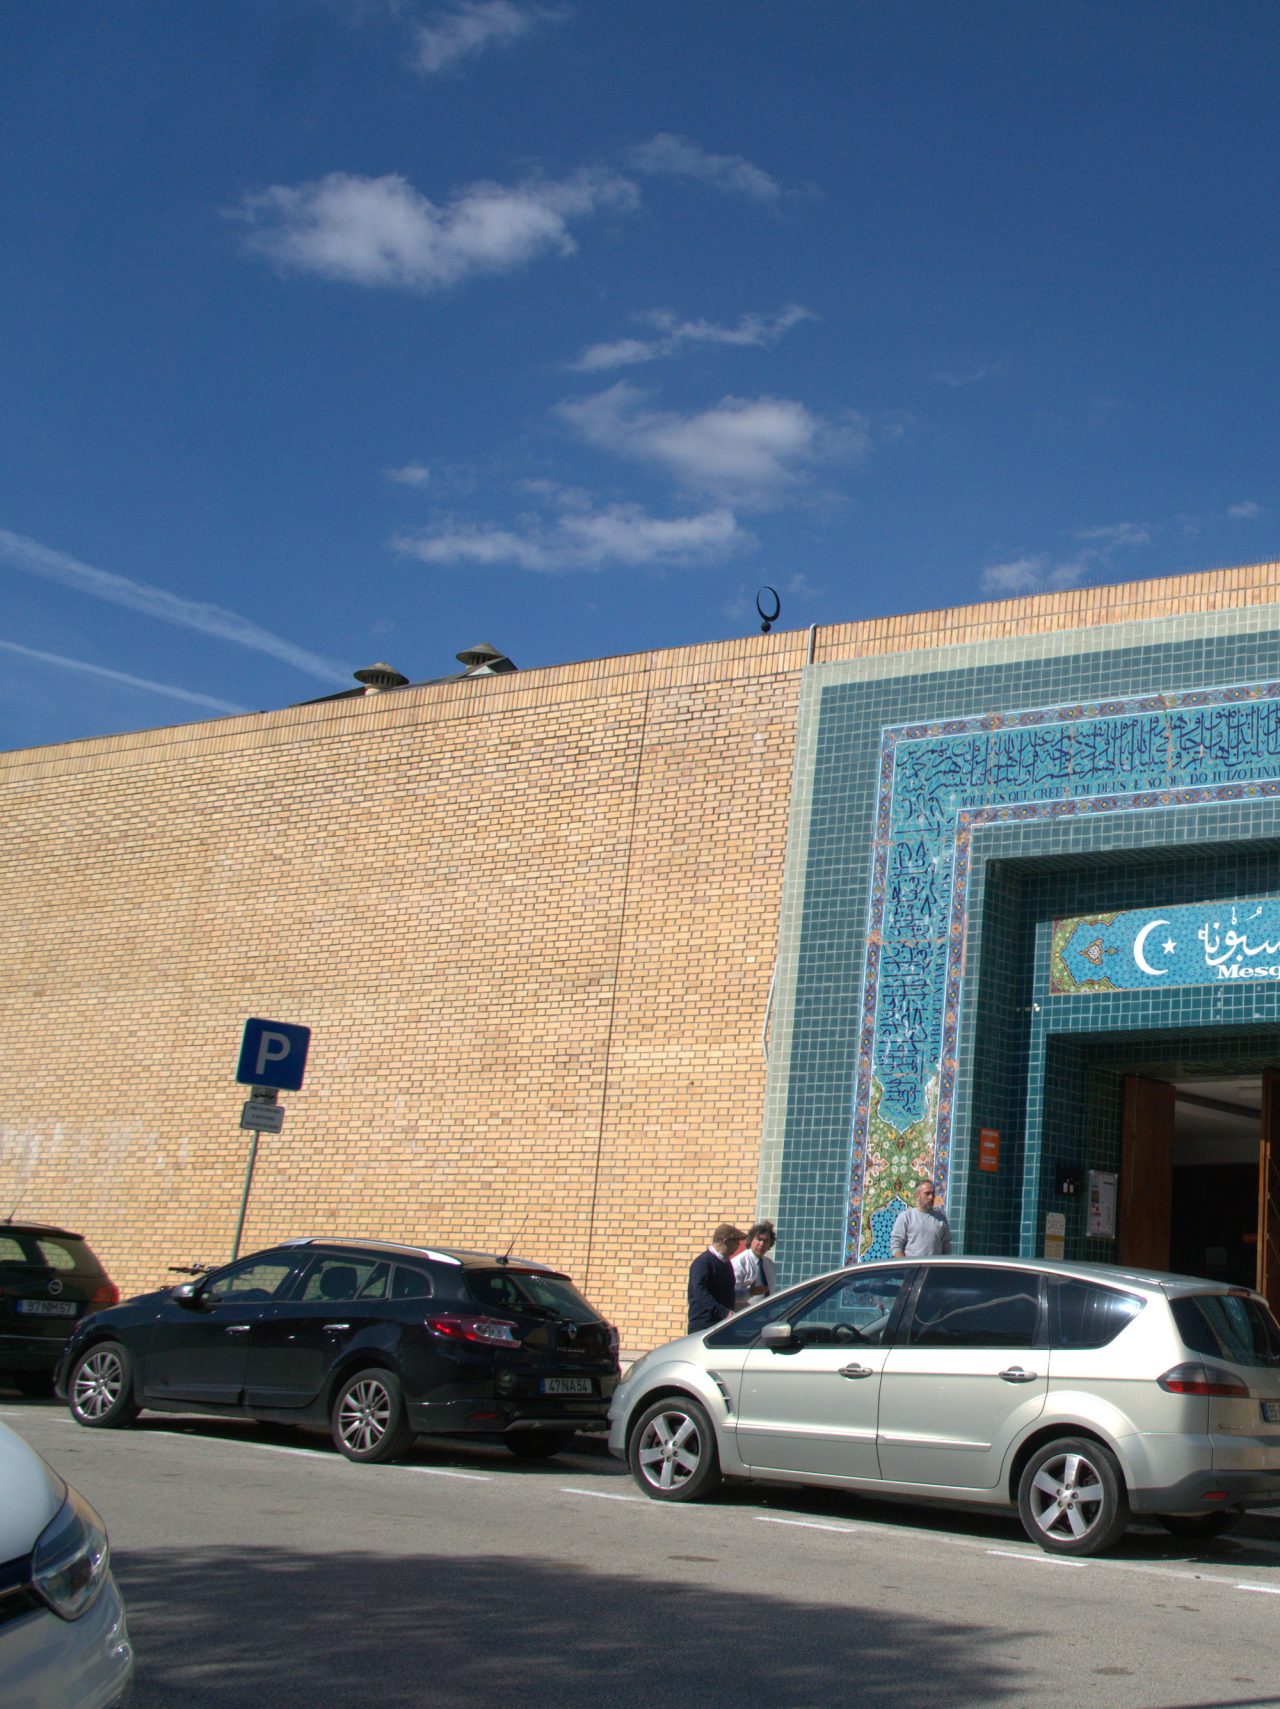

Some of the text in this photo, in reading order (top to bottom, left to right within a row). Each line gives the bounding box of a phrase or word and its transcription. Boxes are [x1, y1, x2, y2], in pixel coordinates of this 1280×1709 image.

[1095, 779, 1127, 794] DEUS
[1189, 771, 1209, 785] DO
[255, 1031, 291, 1075] P
[549, 1379, 588, 1393] 47NA54
